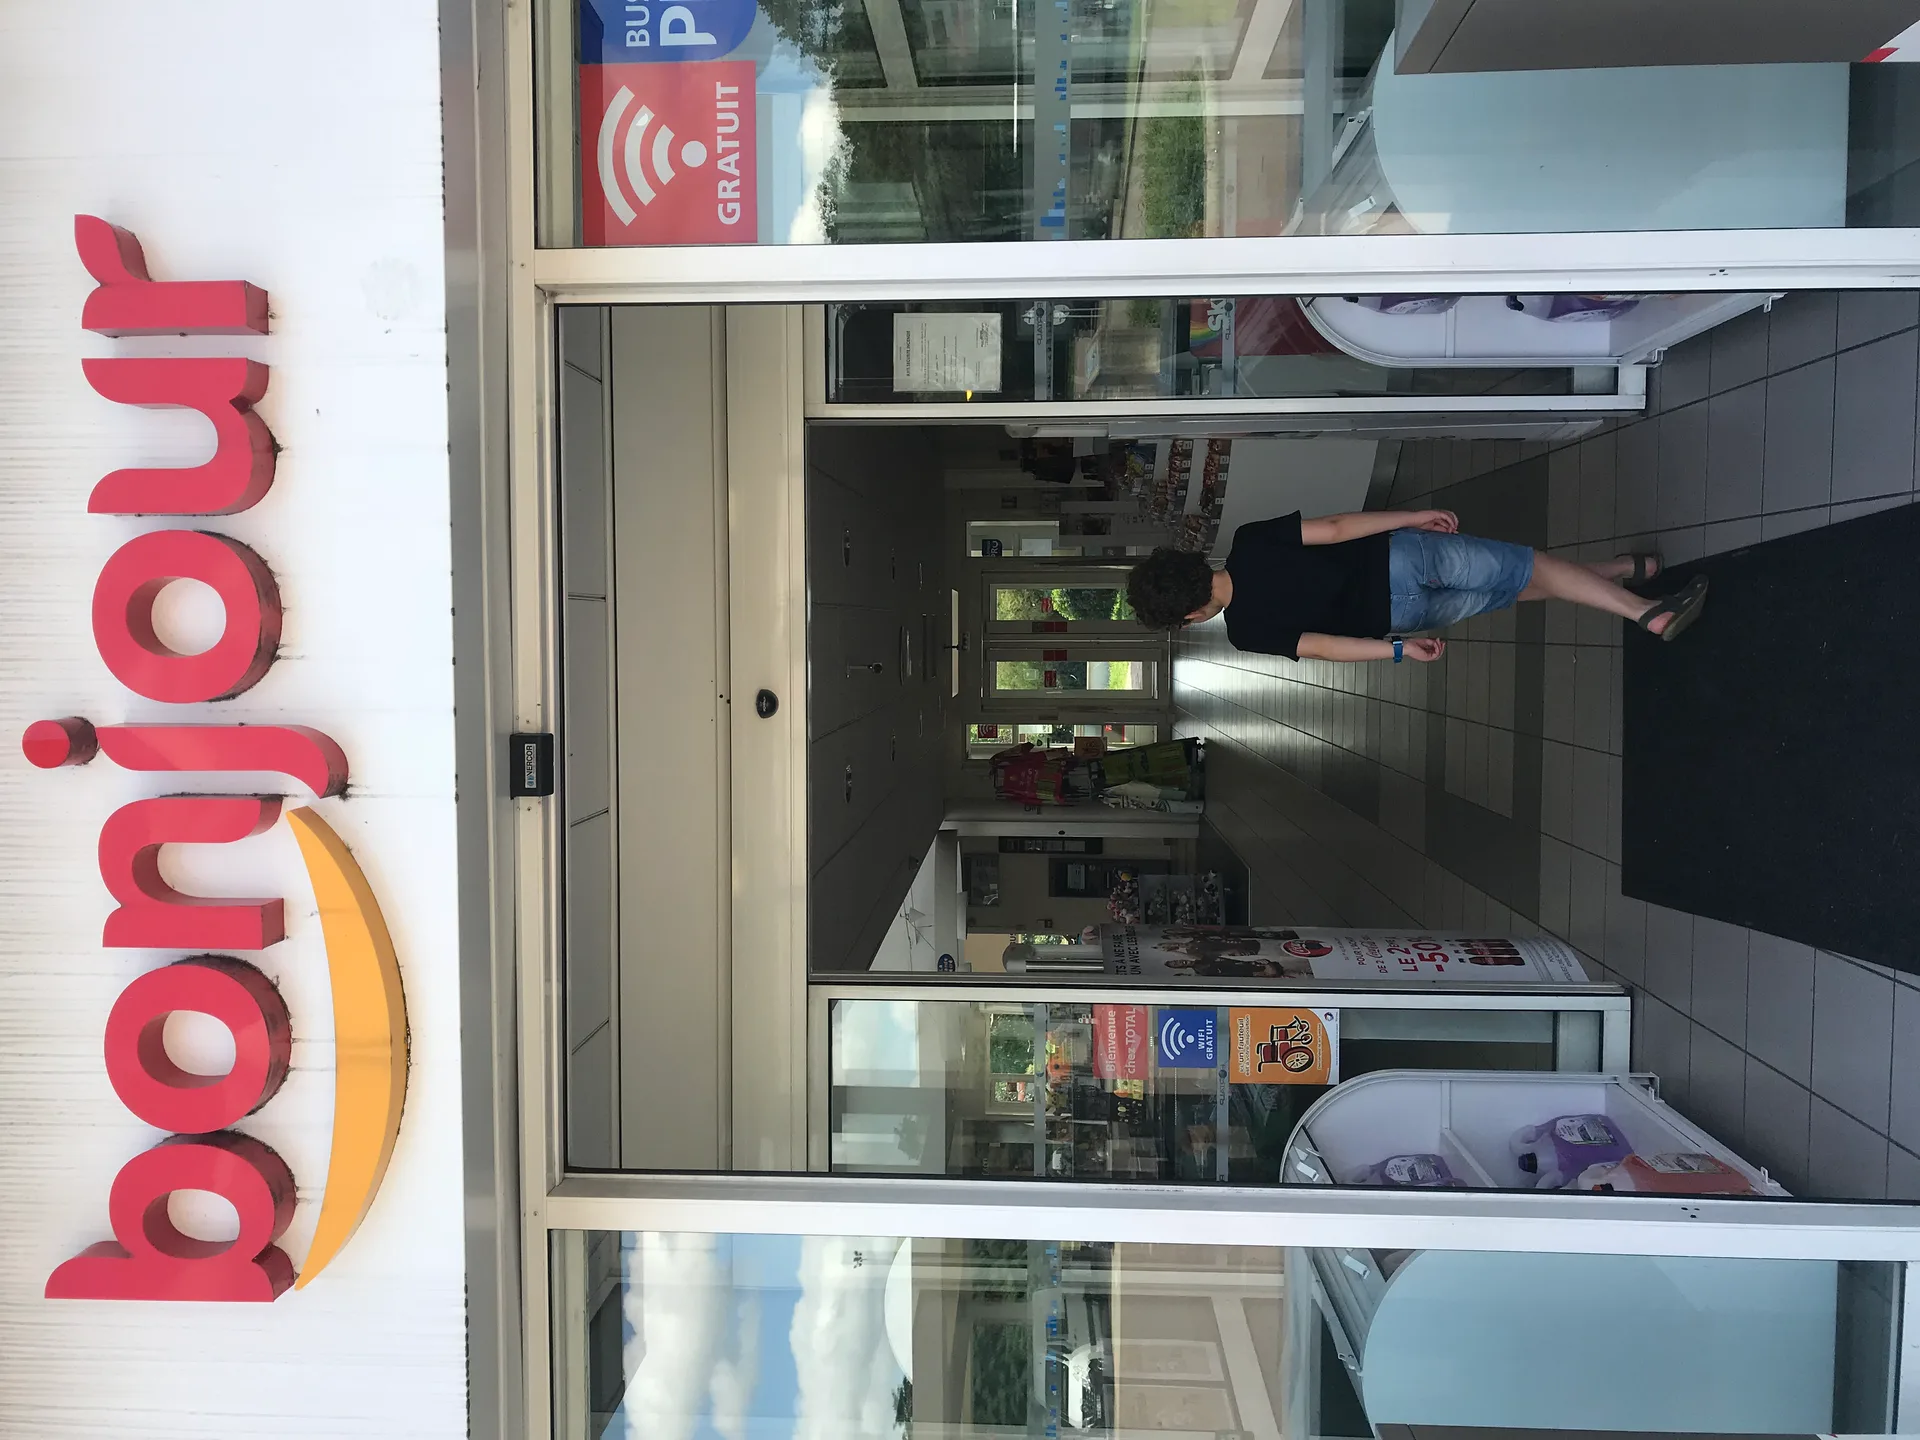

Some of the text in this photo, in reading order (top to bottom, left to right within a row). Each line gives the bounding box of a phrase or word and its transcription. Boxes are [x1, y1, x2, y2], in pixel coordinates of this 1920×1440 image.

[625, 0, 650, 47] BU
[659, 0, 718, 46] P
[716, 81, 741, 225] GRATUIT
[21, 213, 349, 1302] bonjour
[1114, 949, 1125, 958] NE
[1128, 946, 1140, 964] AVEC
[1354, 950, 1367, 965] POUR
[1398, 958, 1419, 972] LE
[1114, 965, 1127, 975] TS
[1378, 965, 1388, 974] DE
[1106, 1010, 1116, 1072] Bienvenue
[1125, 1008, 1136, 1074] chez TOTAL
[1205, 1019, 1213, 1060] GRATUIT
[1239, 1052, 1244, 1062] un
